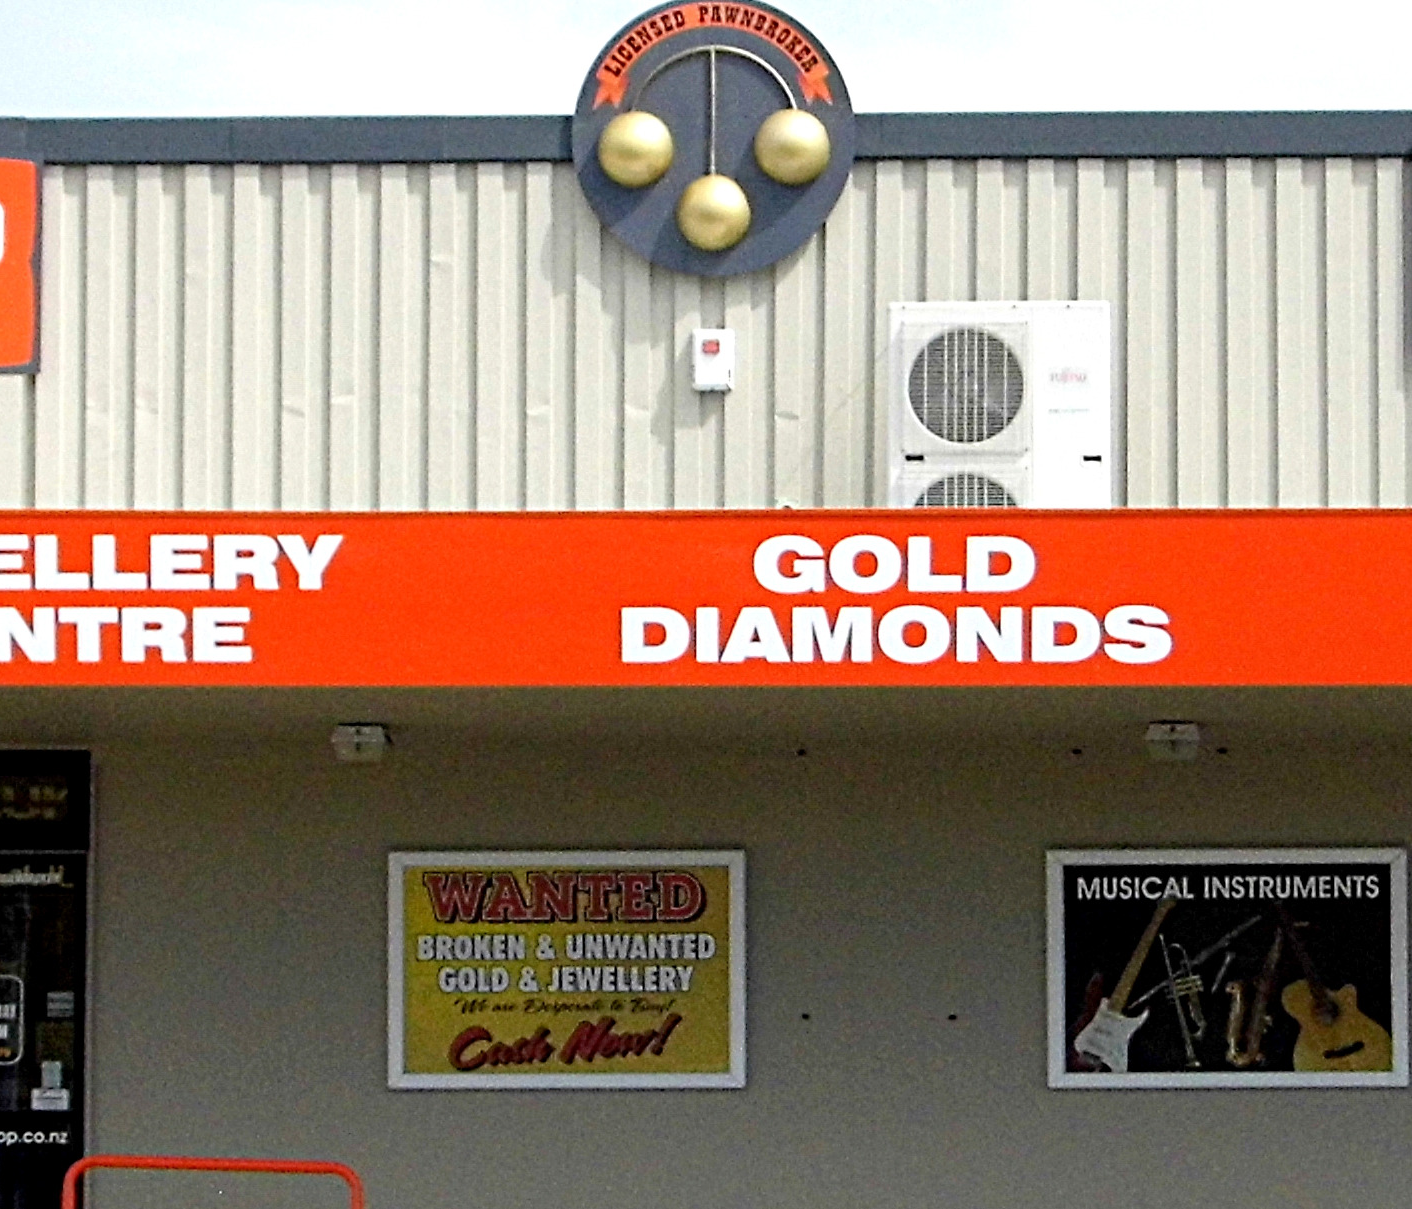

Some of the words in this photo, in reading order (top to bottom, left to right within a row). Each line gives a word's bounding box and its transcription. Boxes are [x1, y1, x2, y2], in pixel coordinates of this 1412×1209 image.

[603, 10, 686, 77] LICENSED
[698, 5, 819, 72] PAWNBROKER
[753, 534, 1036, 593] GOLD
[621, 604, 1172, 664] DIAMONDS
[423, 870, 707, 923] WANTED
[1077, 876, 1194, 899] MUSICAL
[1203, 874, 1379, 899] INSTRUMENTS
[416, 934, 526, 961] BROKEN
[536, 934, 556, 960] &
[566, 933, 717, 960] UNWANTED
[439, 966, 509, 992] GOLD
[519, 966, 539, 992] &
[548, 965, 694, 992] JEWELLERY
[447, 1025, 556, 1071] Cash
[559, 1012, 683, 1065] Now!
